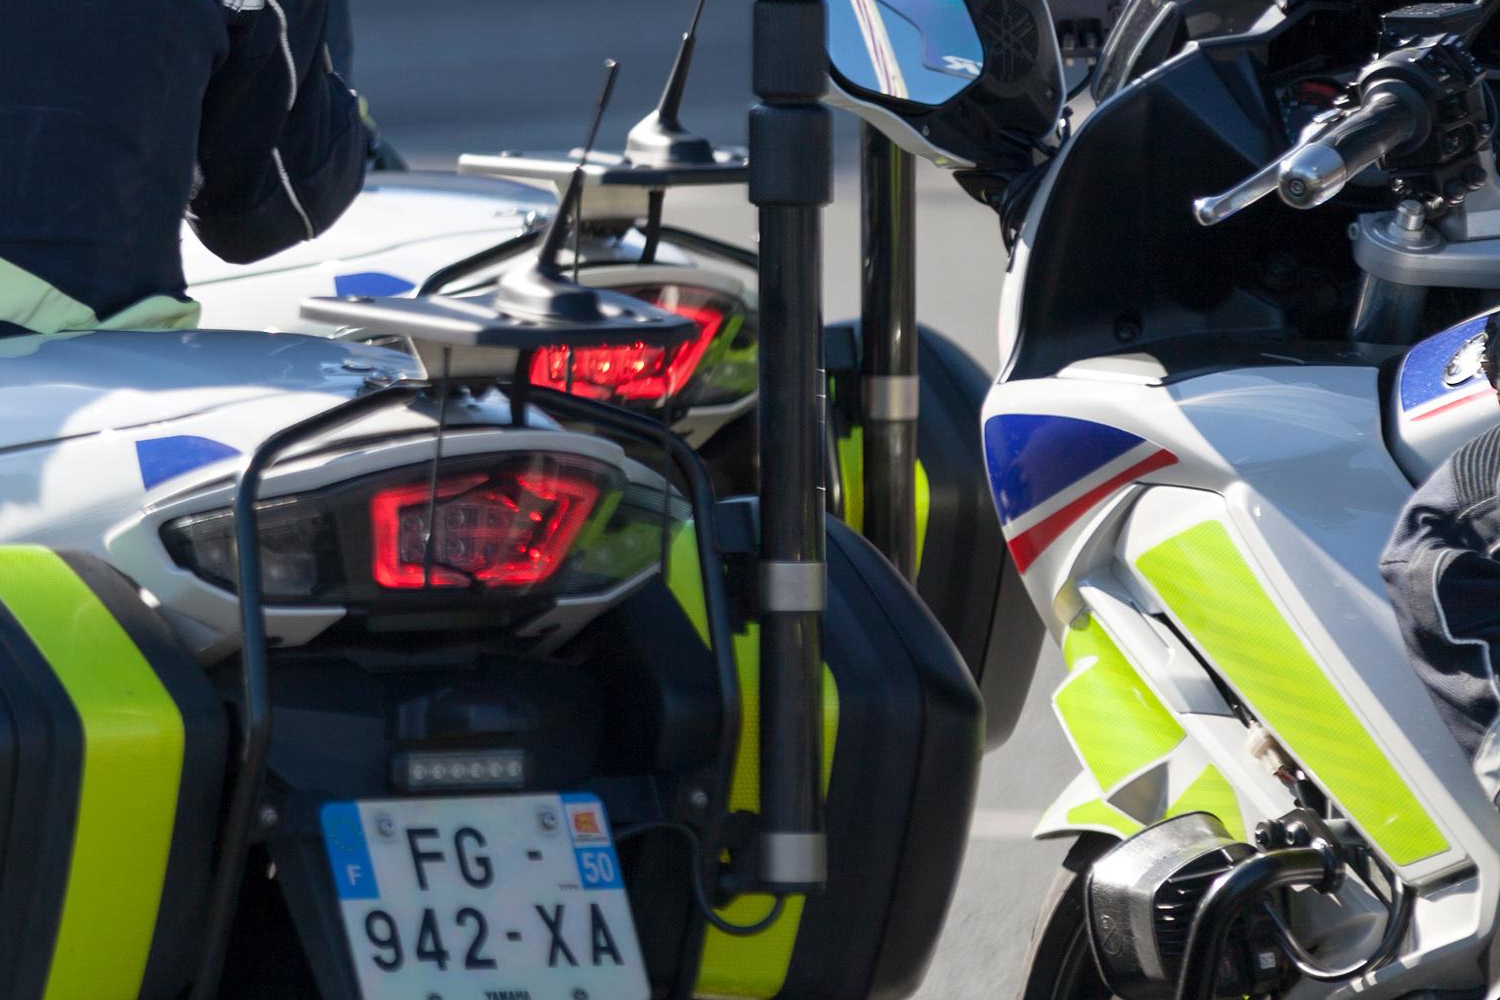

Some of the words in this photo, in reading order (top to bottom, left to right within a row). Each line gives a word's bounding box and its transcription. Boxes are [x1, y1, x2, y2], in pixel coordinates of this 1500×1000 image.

[346, 863, 362, 886] F
[406, 827, 495, 891] FG
[581, 851, 615, 884] 50
[364, 903, 626, 973] 942-XA
